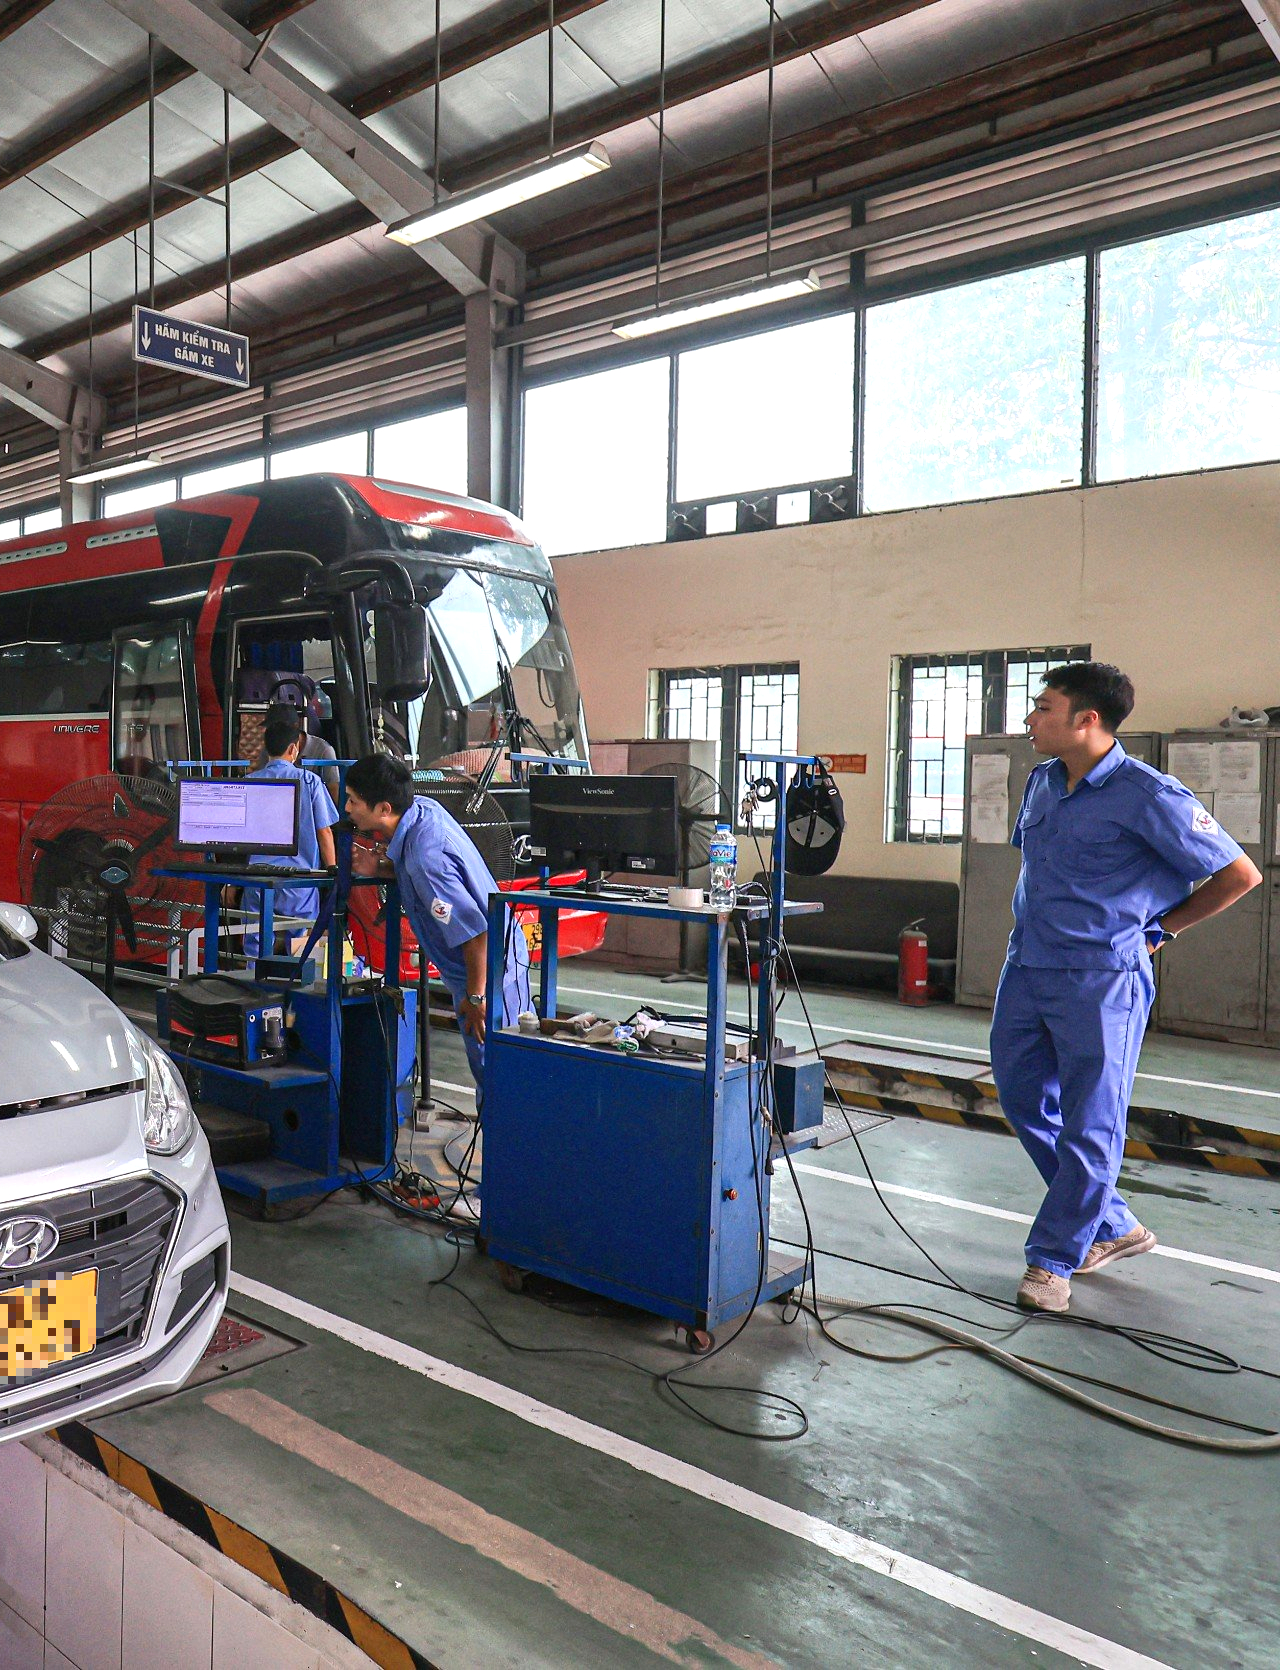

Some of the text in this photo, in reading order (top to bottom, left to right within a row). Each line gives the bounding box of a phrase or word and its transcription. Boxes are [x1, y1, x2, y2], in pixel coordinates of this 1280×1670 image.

[183, 330, 208, 348] KIỂM
[211, 339, 230, 354] TRA
[201, 354, 215, 367] XE
